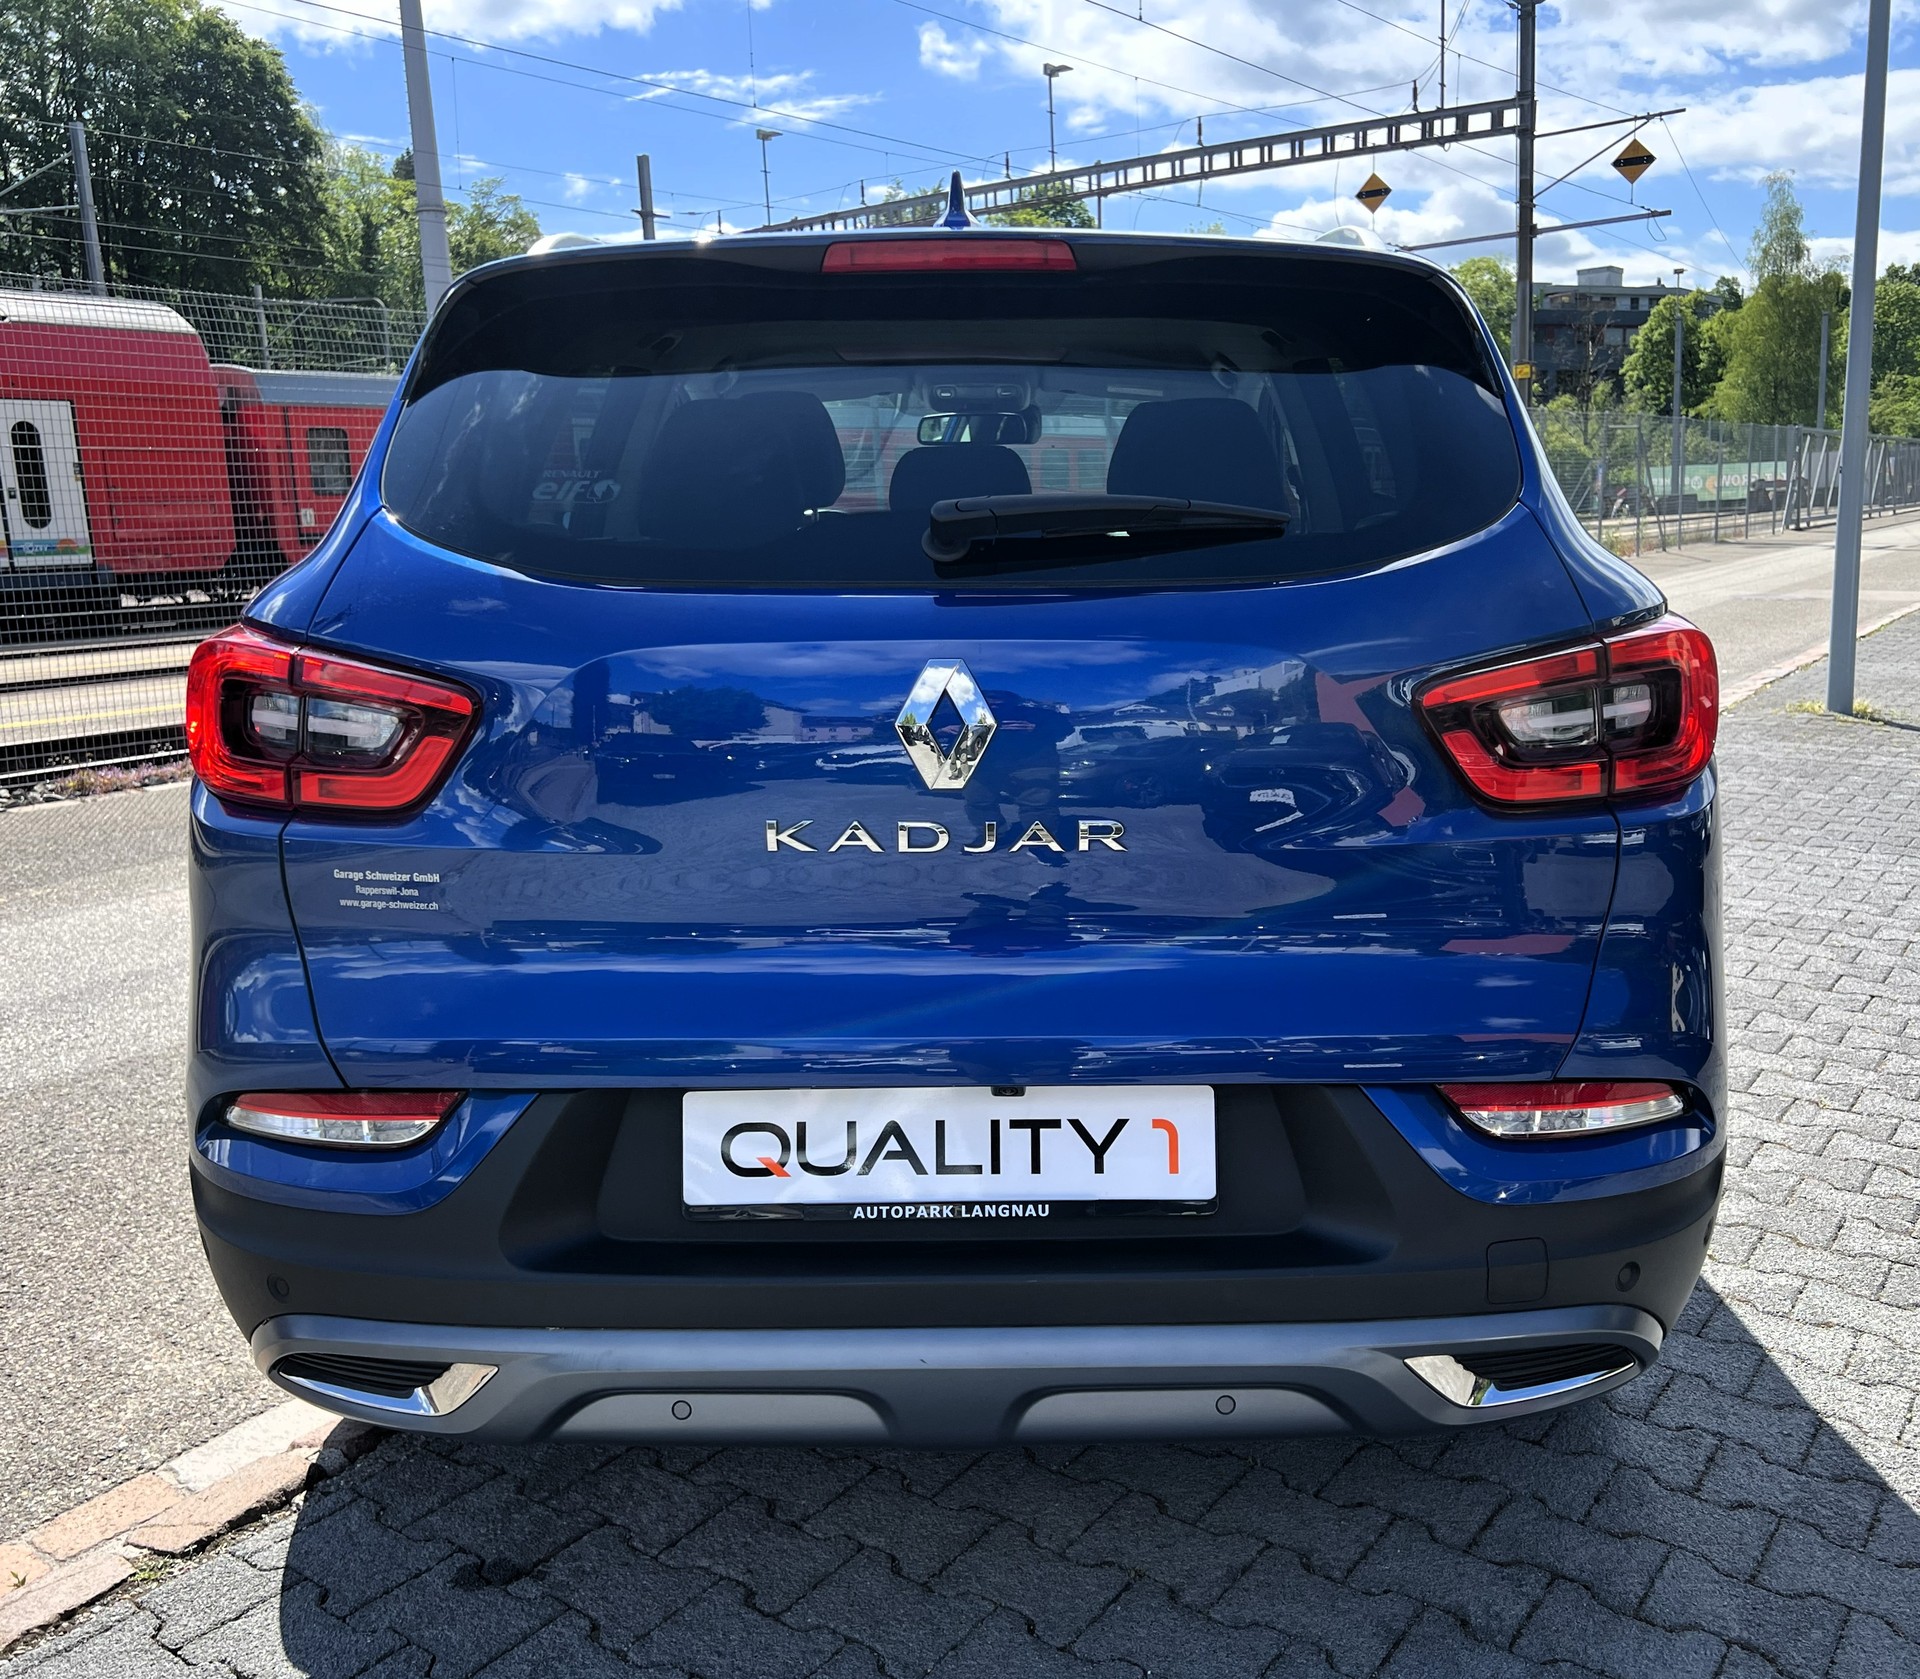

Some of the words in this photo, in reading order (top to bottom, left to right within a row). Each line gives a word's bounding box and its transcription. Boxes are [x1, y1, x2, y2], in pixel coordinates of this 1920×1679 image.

[765, 819, 1128, 853] KADJAR
[333, 868, 364, 882] Garage
[365, 870, 411, 882] Schweizer
[413, 872, 440, 883] GmbH
[355, 884, 419, 897] Rapperswil-Jona
[339, 899, 439, 911] www.garage-schweizer.ch
[720, 1118, 1130, 1178] QUALITY
[1152, 1118, 1180, 1175] 1
[853, 1205, 954, 1220] AUTOPARK
[961, 1204, 1050, 1219] LANGNAU
